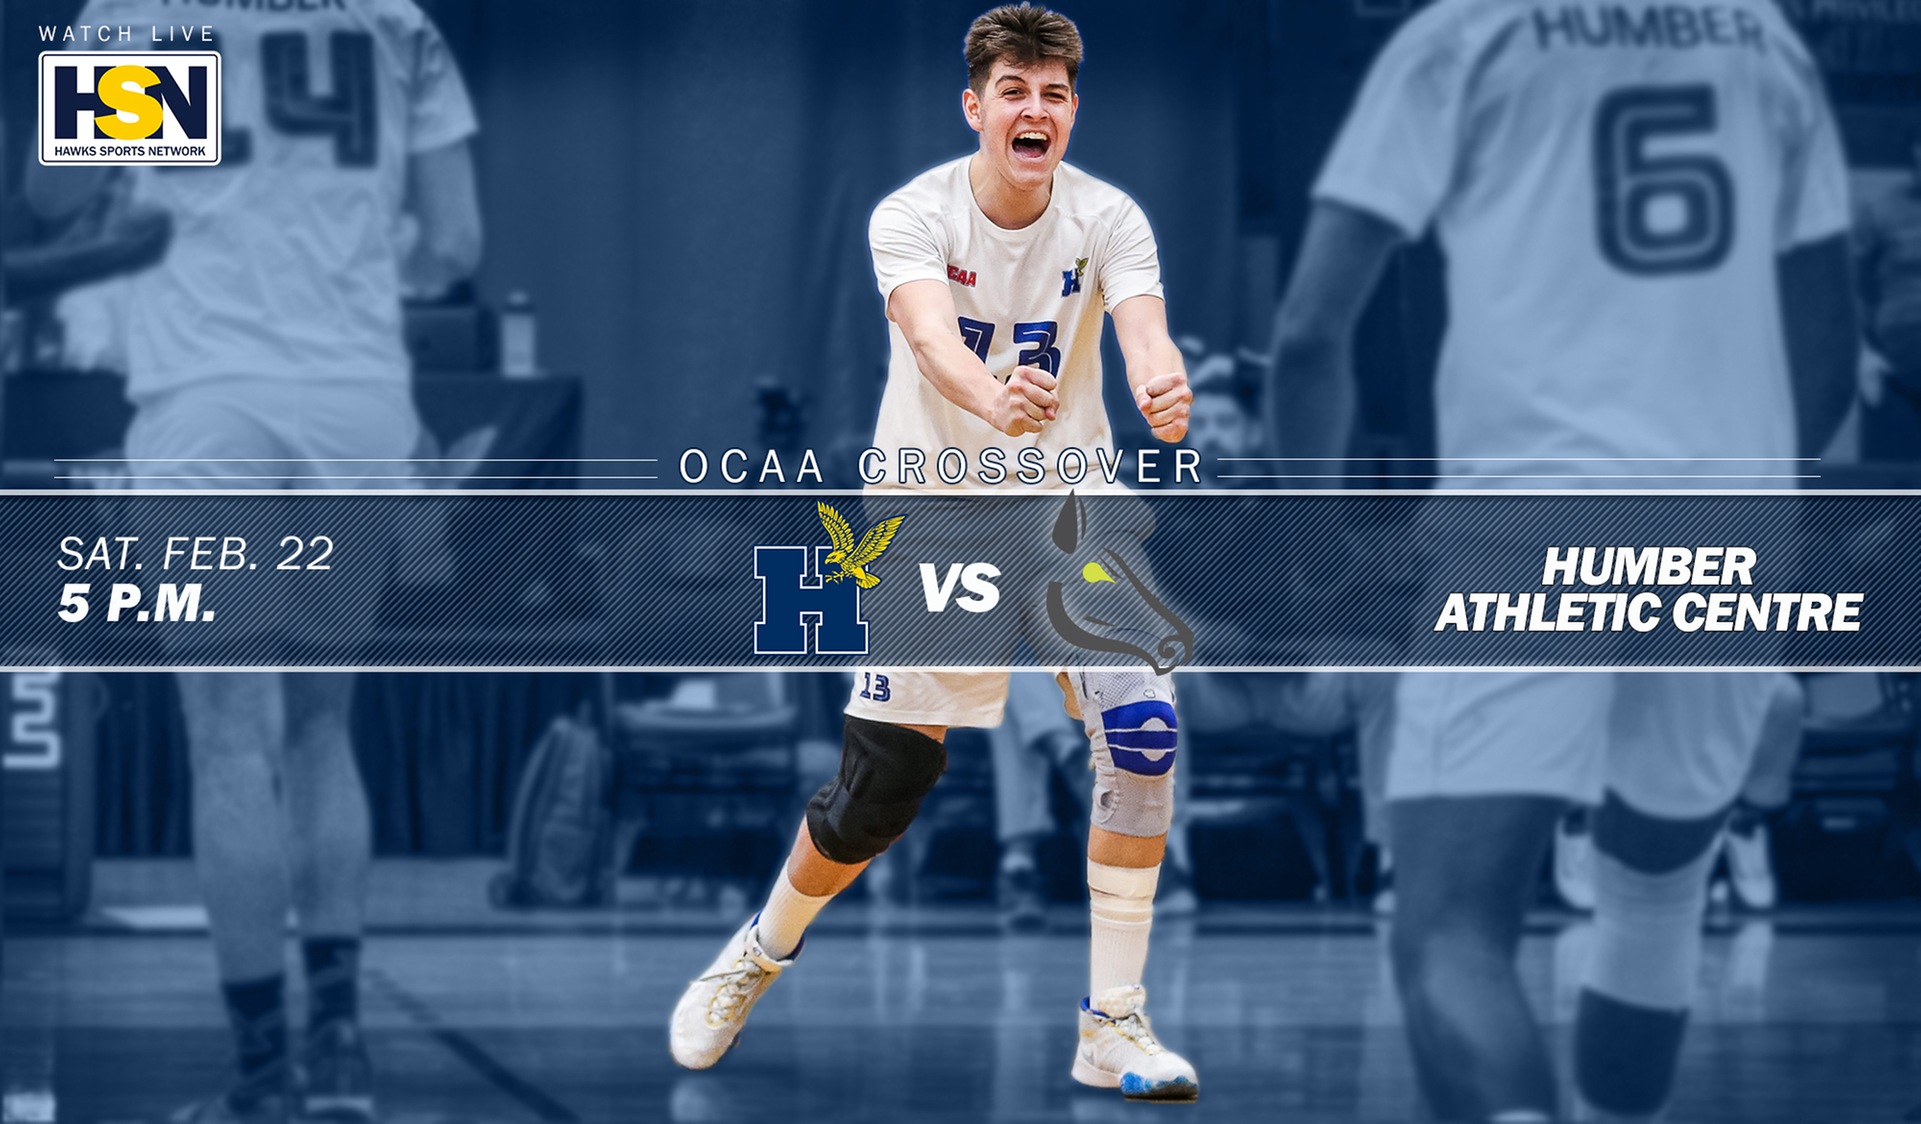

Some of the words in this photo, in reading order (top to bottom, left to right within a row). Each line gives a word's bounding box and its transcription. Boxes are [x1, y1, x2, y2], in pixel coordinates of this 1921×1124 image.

[1531, 4, 1768, 52] HUMBER
[1592, 82, 1736, 278] 6
[860, 671, 891, 702] 13
